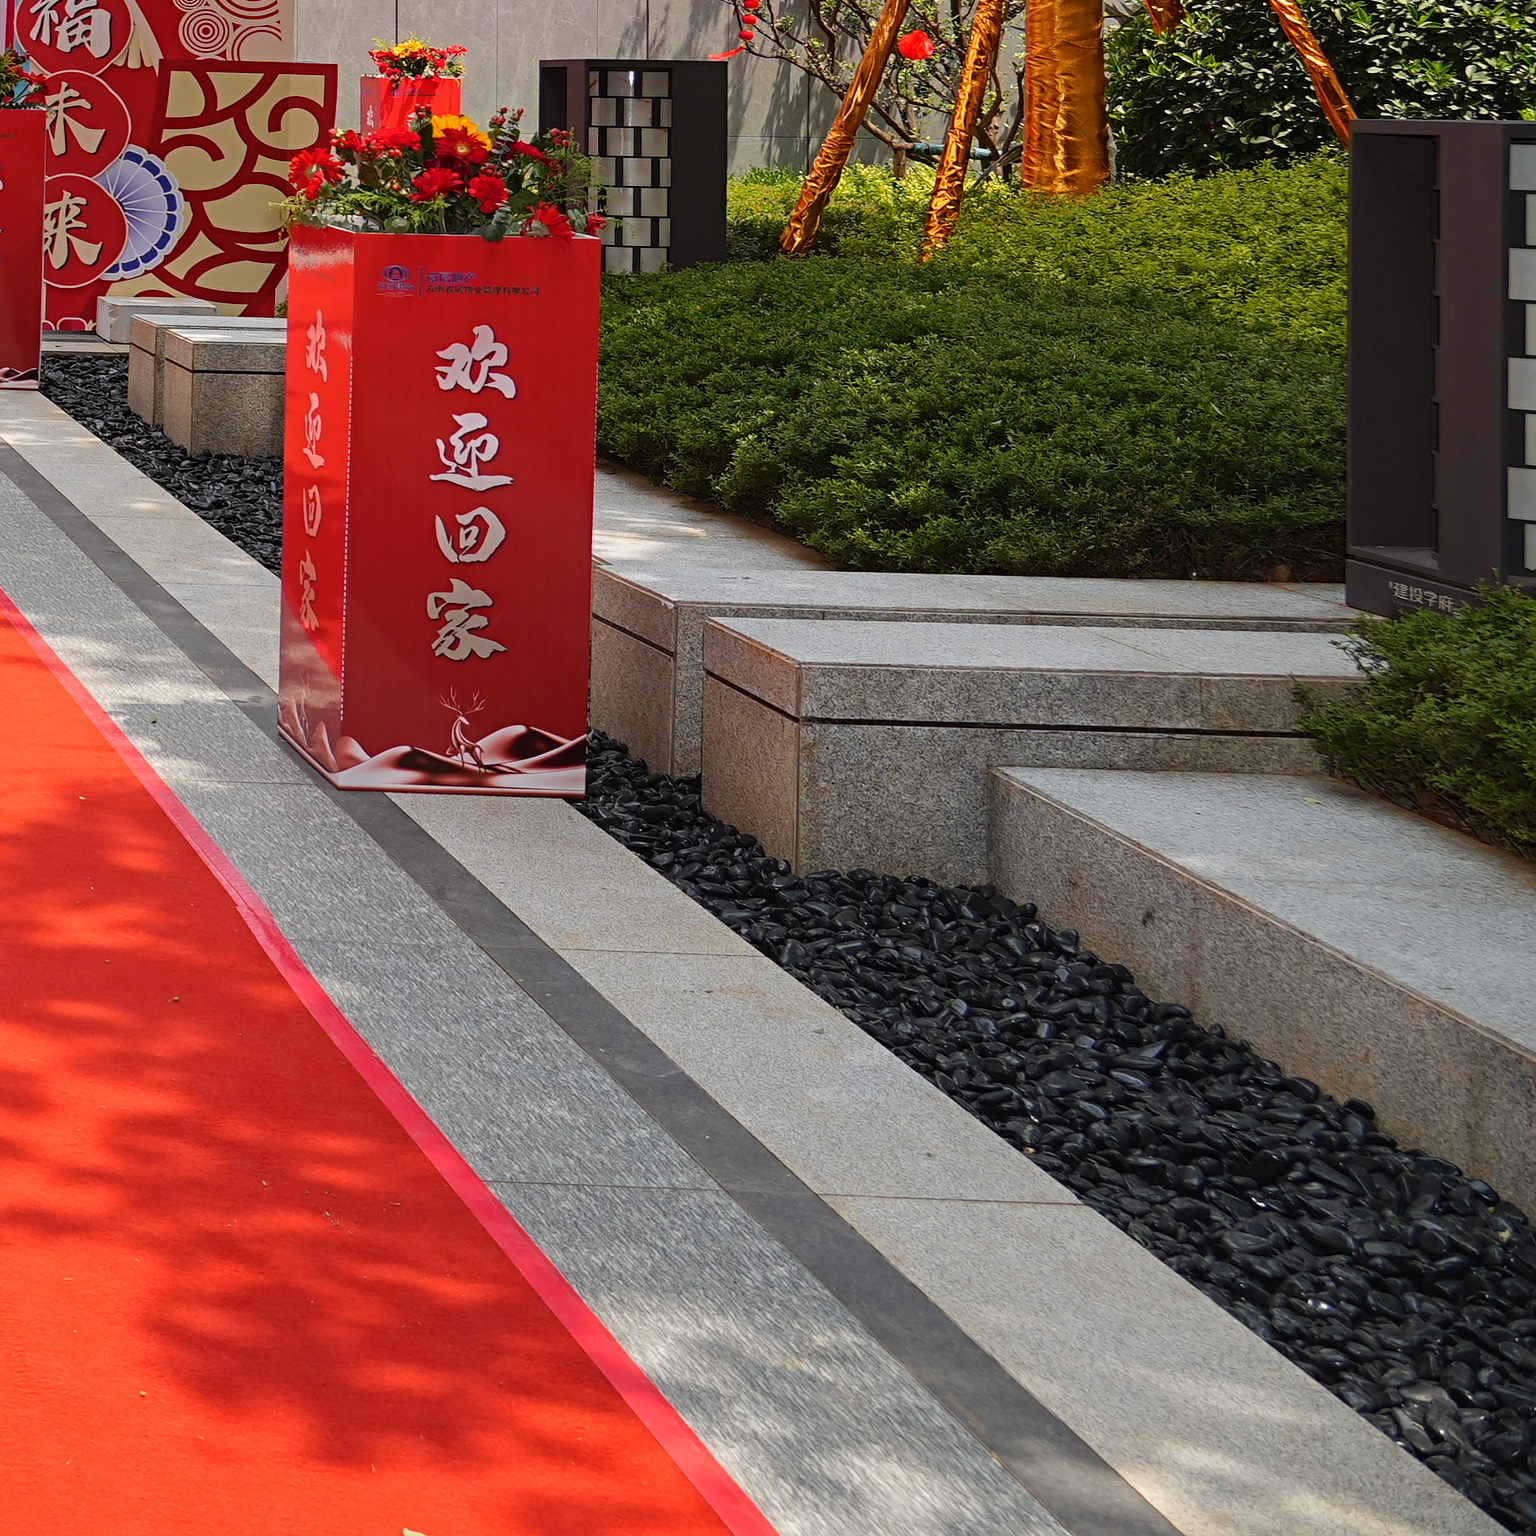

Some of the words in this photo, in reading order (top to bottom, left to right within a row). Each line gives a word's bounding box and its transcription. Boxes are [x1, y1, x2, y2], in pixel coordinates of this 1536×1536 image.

[299, 309, 328, 633] 欢迎回家
[426, 324, 518, 663] 欢迎回家
[1393, 582, 1454, 613] 建投学府
